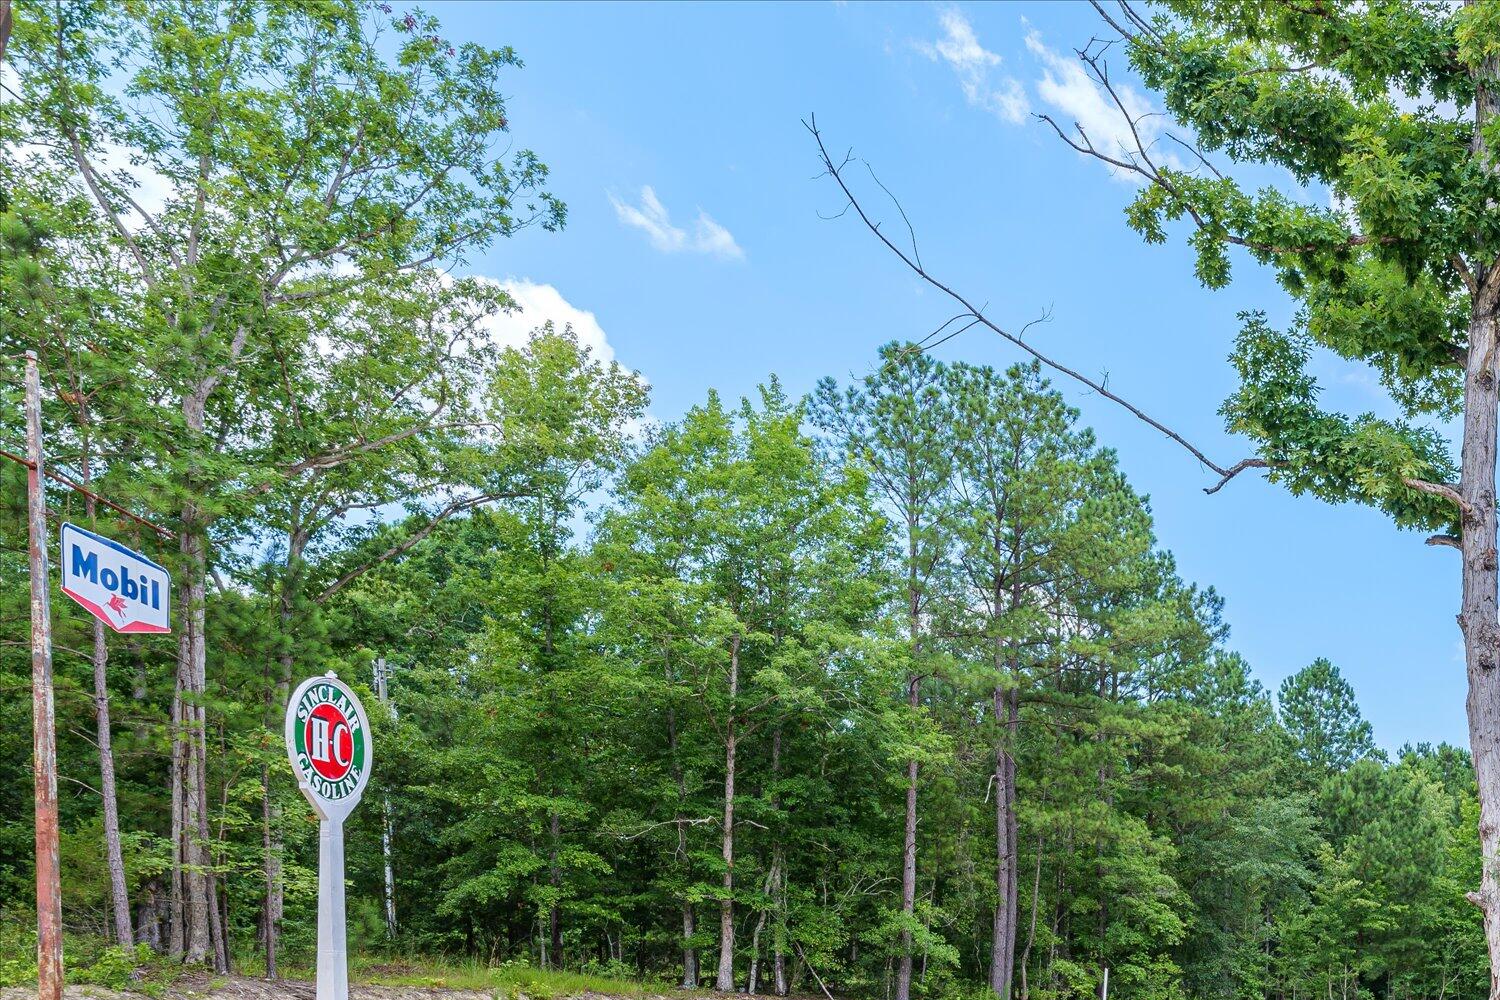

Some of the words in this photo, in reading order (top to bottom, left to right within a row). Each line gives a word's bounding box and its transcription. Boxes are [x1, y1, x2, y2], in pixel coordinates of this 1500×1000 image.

[72, 543, 160, 611] Mobil
[297, 685, 361, 733] SINCLAIR
[298, 752, 362, 799] GASOLINE
